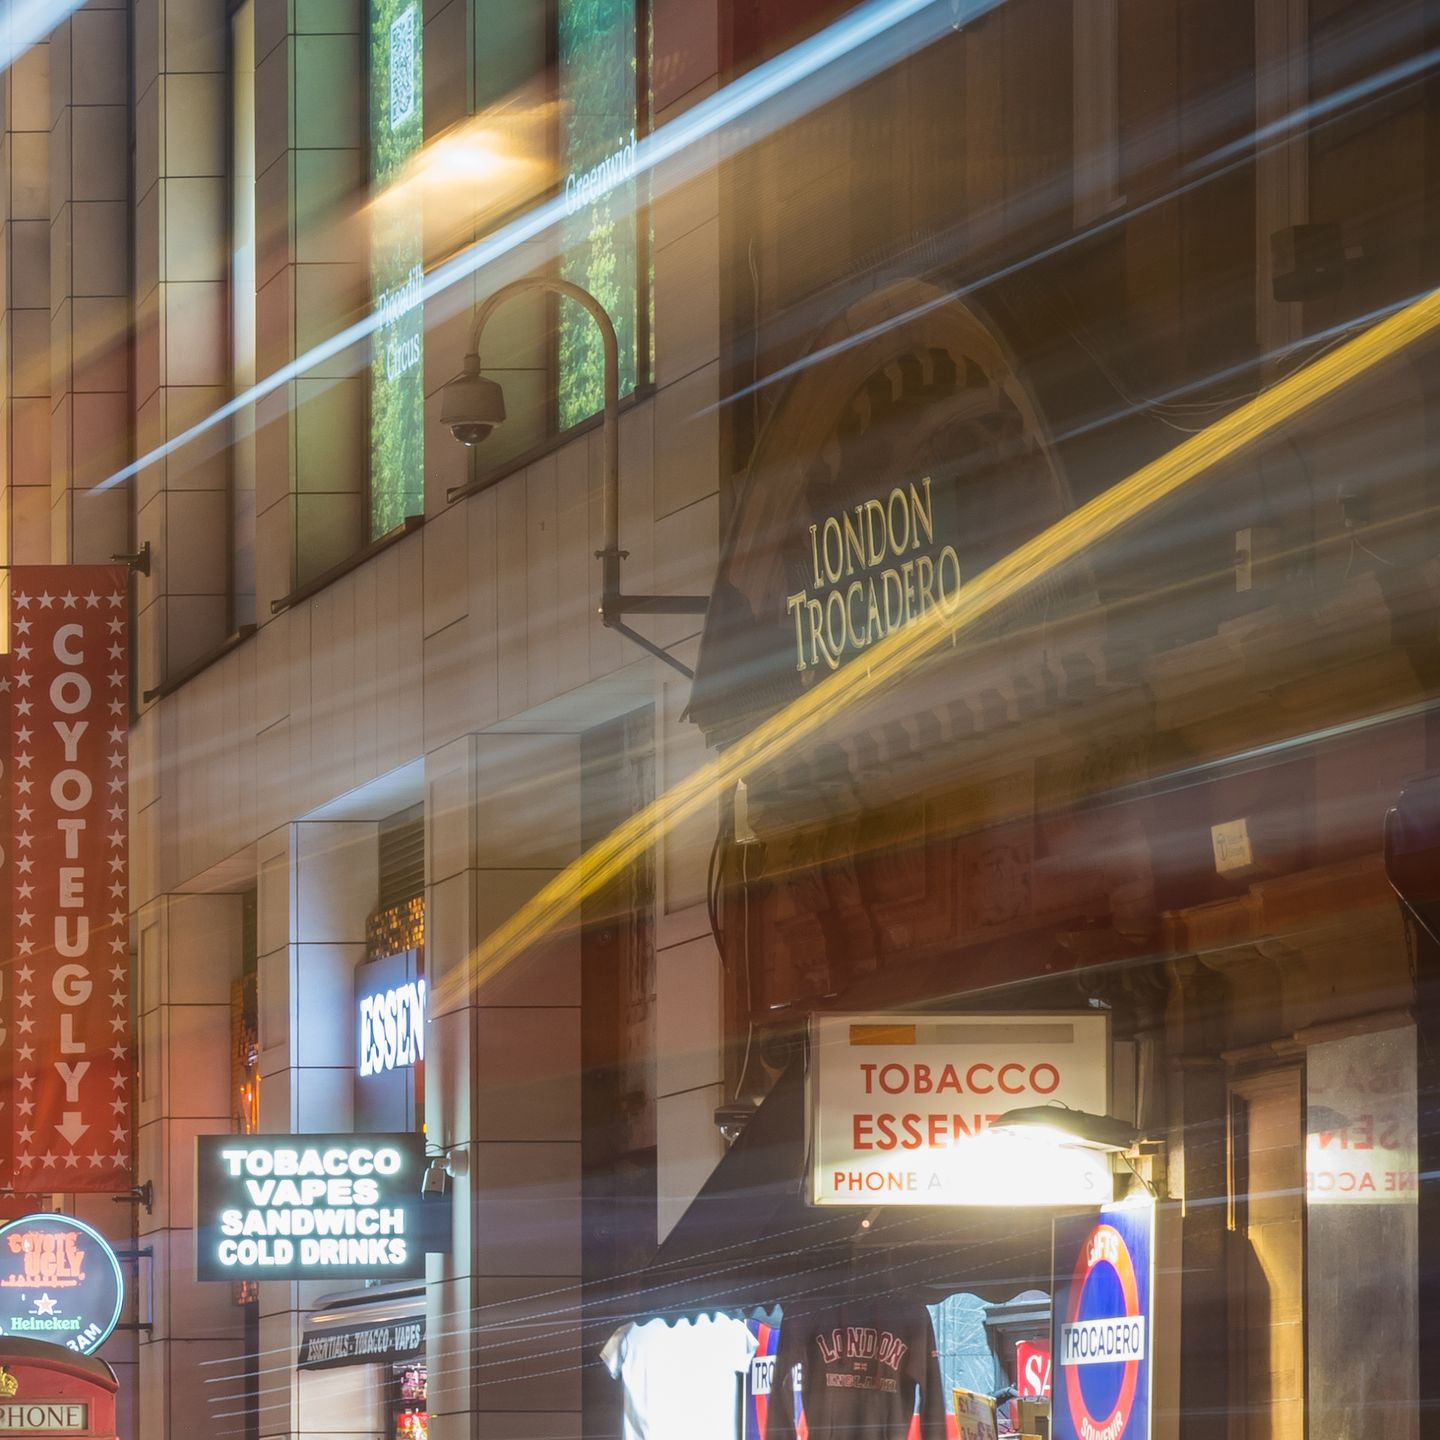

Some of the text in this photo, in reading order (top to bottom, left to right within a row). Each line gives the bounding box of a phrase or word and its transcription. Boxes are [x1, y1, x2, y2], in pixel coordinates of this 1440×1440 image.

[808, 476, 934, 590] LONDON
[786, 545, 962, 673] TROCADERO
[860, 1063, 1060, 1095] TOBACCO
[222, 1148, 402, 1176] TOBACCO
[246, 1178, 380, 1206] VAPES
[833, 1172, 918, 1191] PHONE
[220, 1208, 405, 1237] SANDWICH
[7, 1232, 78, 1254] COYOTE
[218, 1237, 408, 1266] COLD DRINKS
[1087, 1231, 1119, 1266] GIFTS
[23, 1251, 86, 1278] UGLY
[11, 1317, 80, 1332] Heineken
[307, 1323, 421, 1361] ESSENTIALS TOBACCO VAPES
[816, 1327, 908, 1371] LONDON
[1064, 1323, 1140, 1360] TROCADERO
